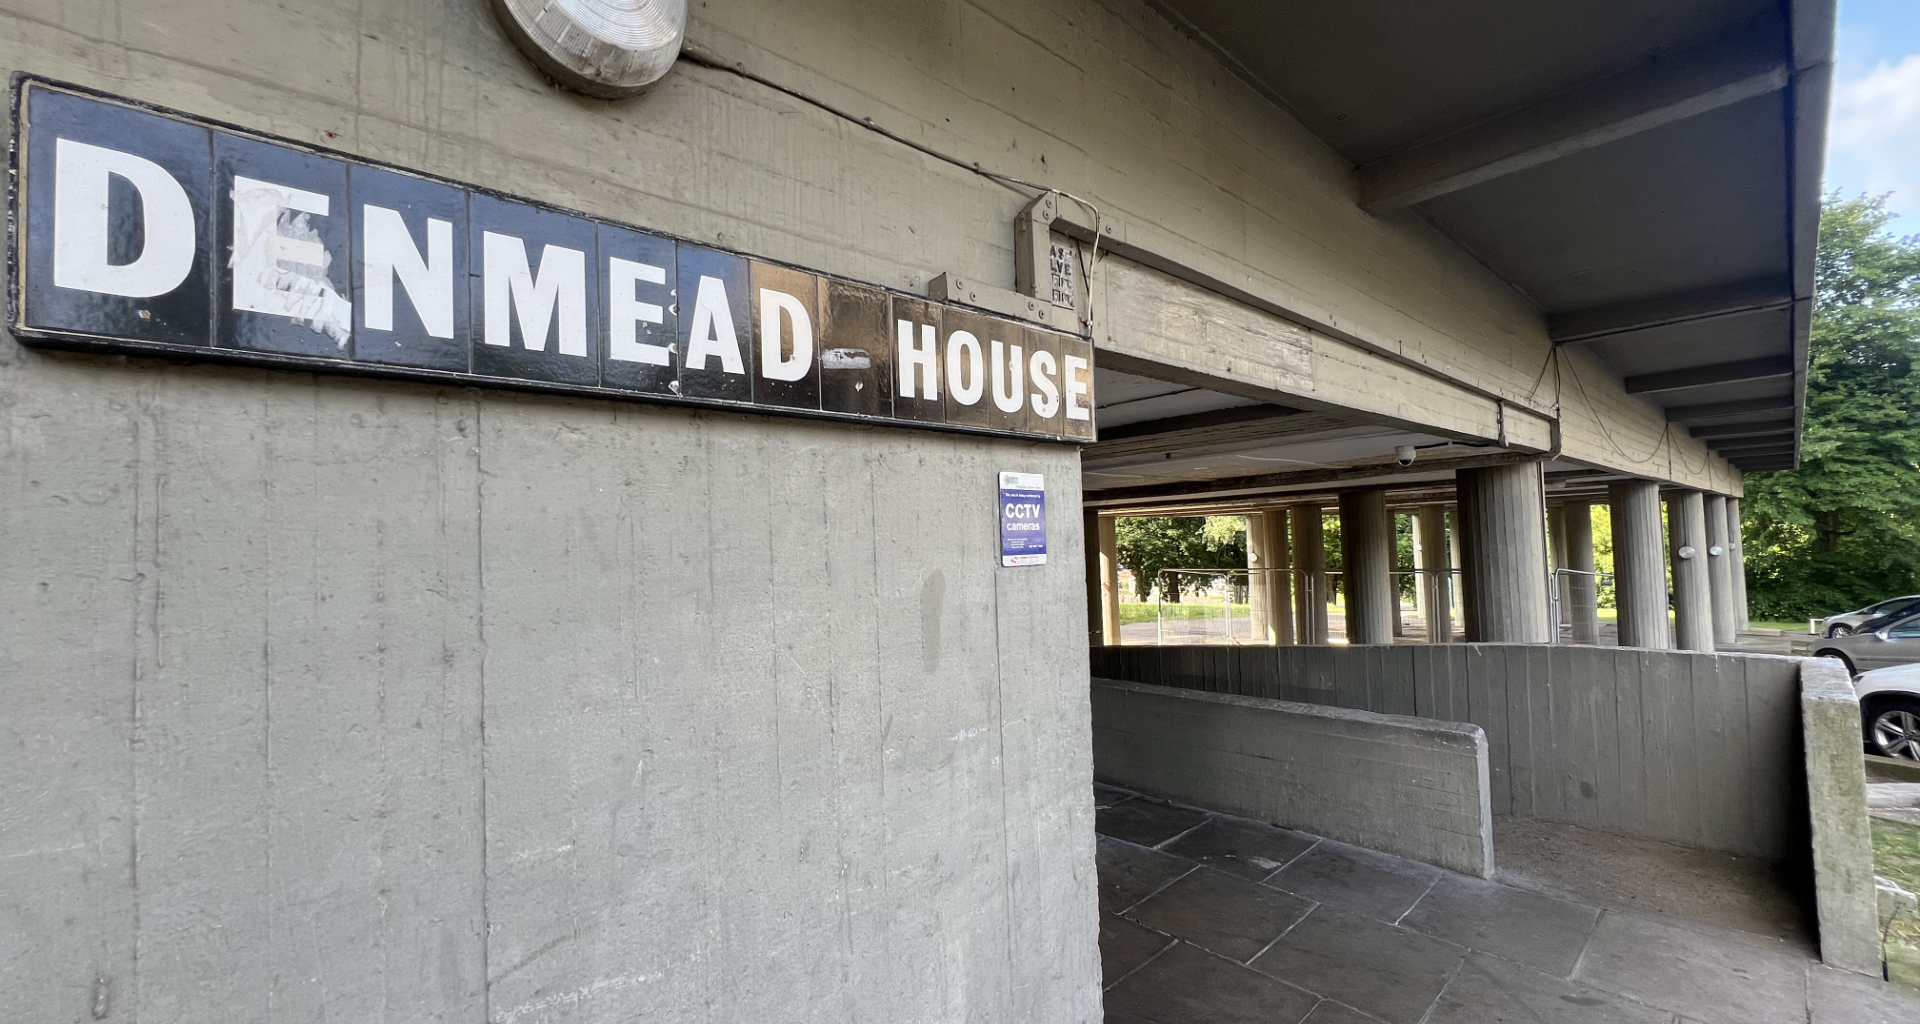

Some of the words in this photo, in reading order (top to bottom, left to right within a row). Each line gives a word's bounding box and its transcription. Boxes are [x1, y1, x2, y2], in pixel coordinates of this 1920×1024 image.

[53, 137, 812, 382] DENMEAD
[897, 319, 1091, 422] HOUSE
[1005, 503, 1041, 519] CCTV
[1006, 522, 1040, 531] cameras
